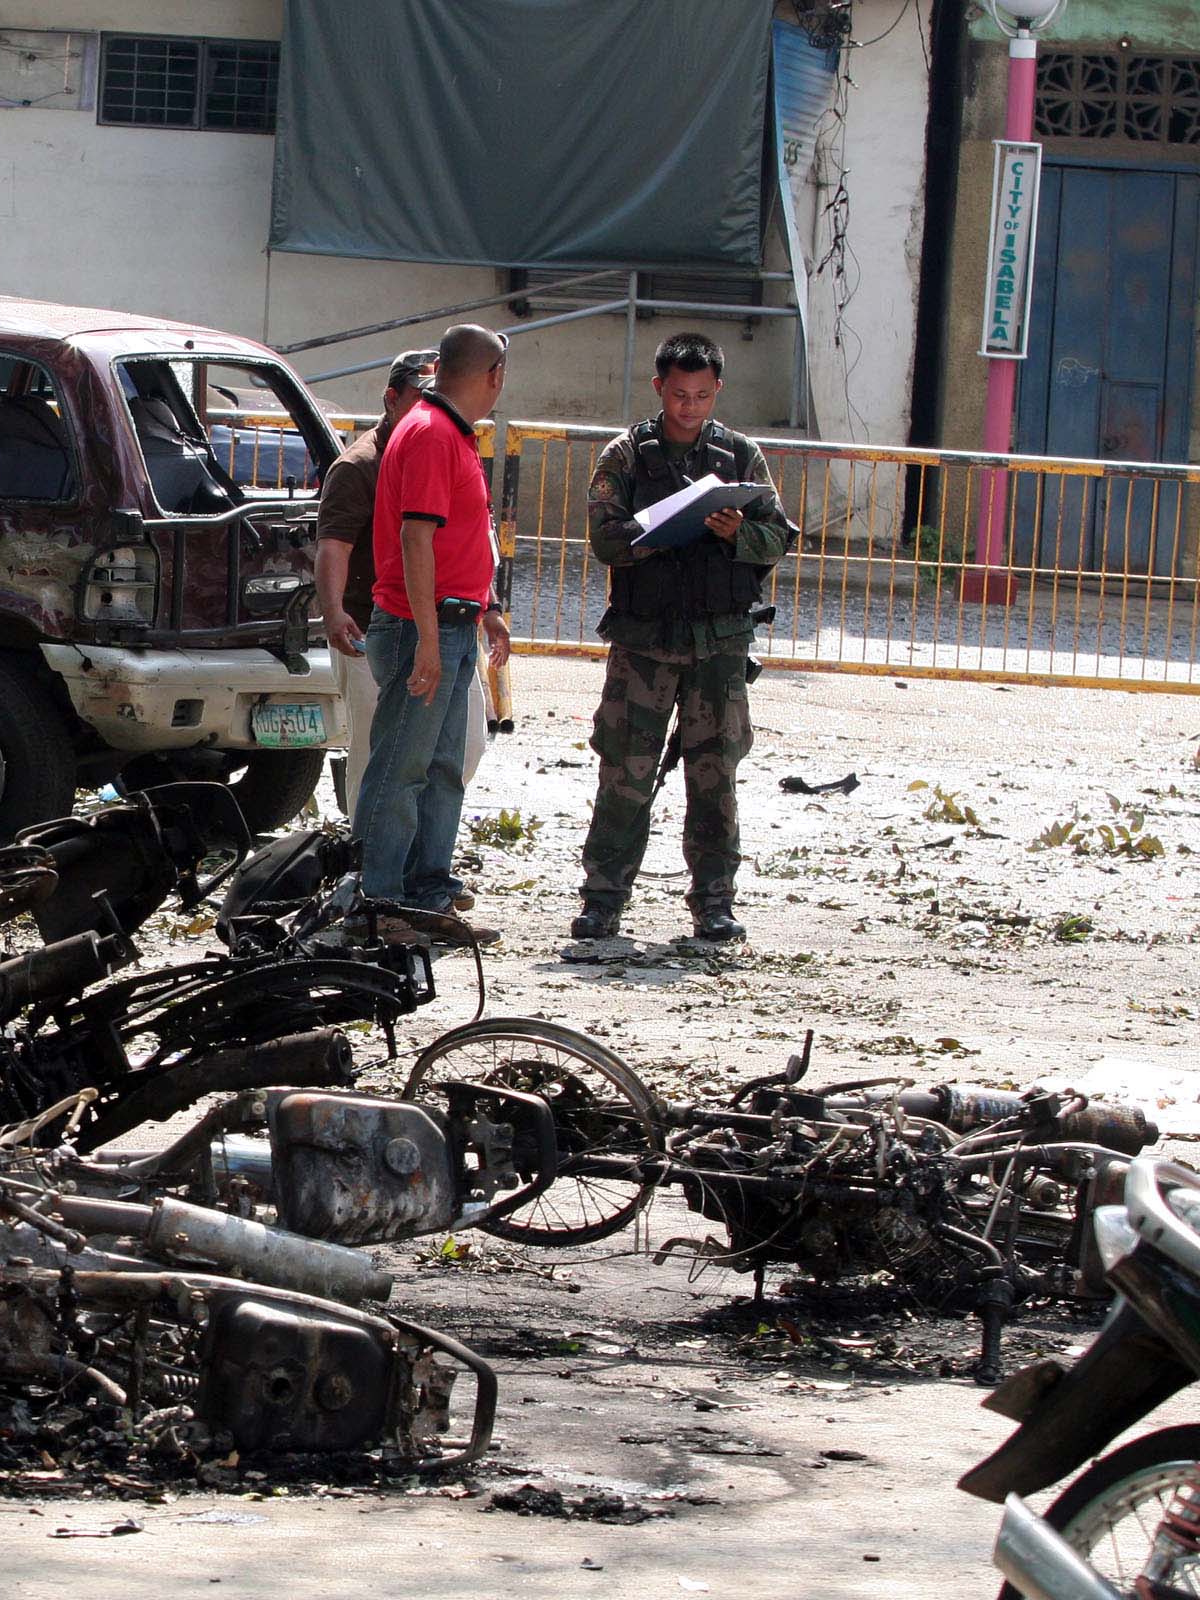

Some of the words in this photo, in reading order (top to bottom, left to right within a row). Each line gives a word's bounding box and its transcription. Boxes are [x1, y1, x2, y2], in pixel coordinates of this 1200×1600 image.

[1007, 162, 1024, 218] CITY
[1003, 221, 1019, 230] OF
[991, 234, 1017, 341] ISABELA
